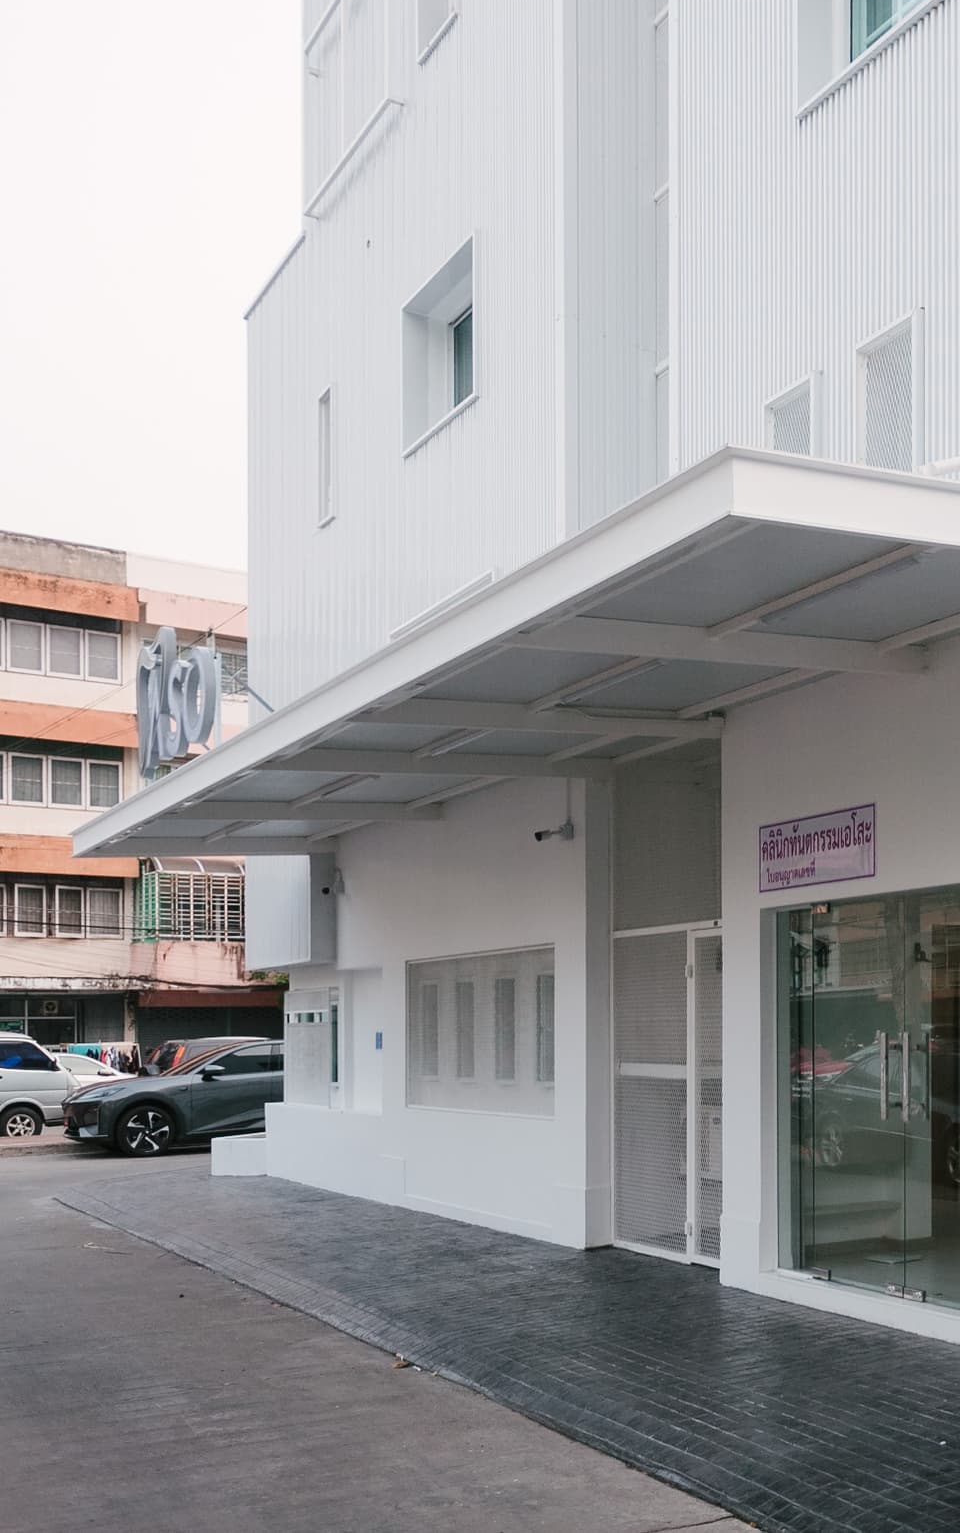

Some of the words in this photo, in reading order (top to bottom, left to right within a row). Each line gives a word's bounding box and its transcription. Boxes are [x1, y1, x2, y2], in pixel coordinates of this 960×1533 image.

[762, 811, 872, 862] คลินิกทันตกรรมเอโสะ
